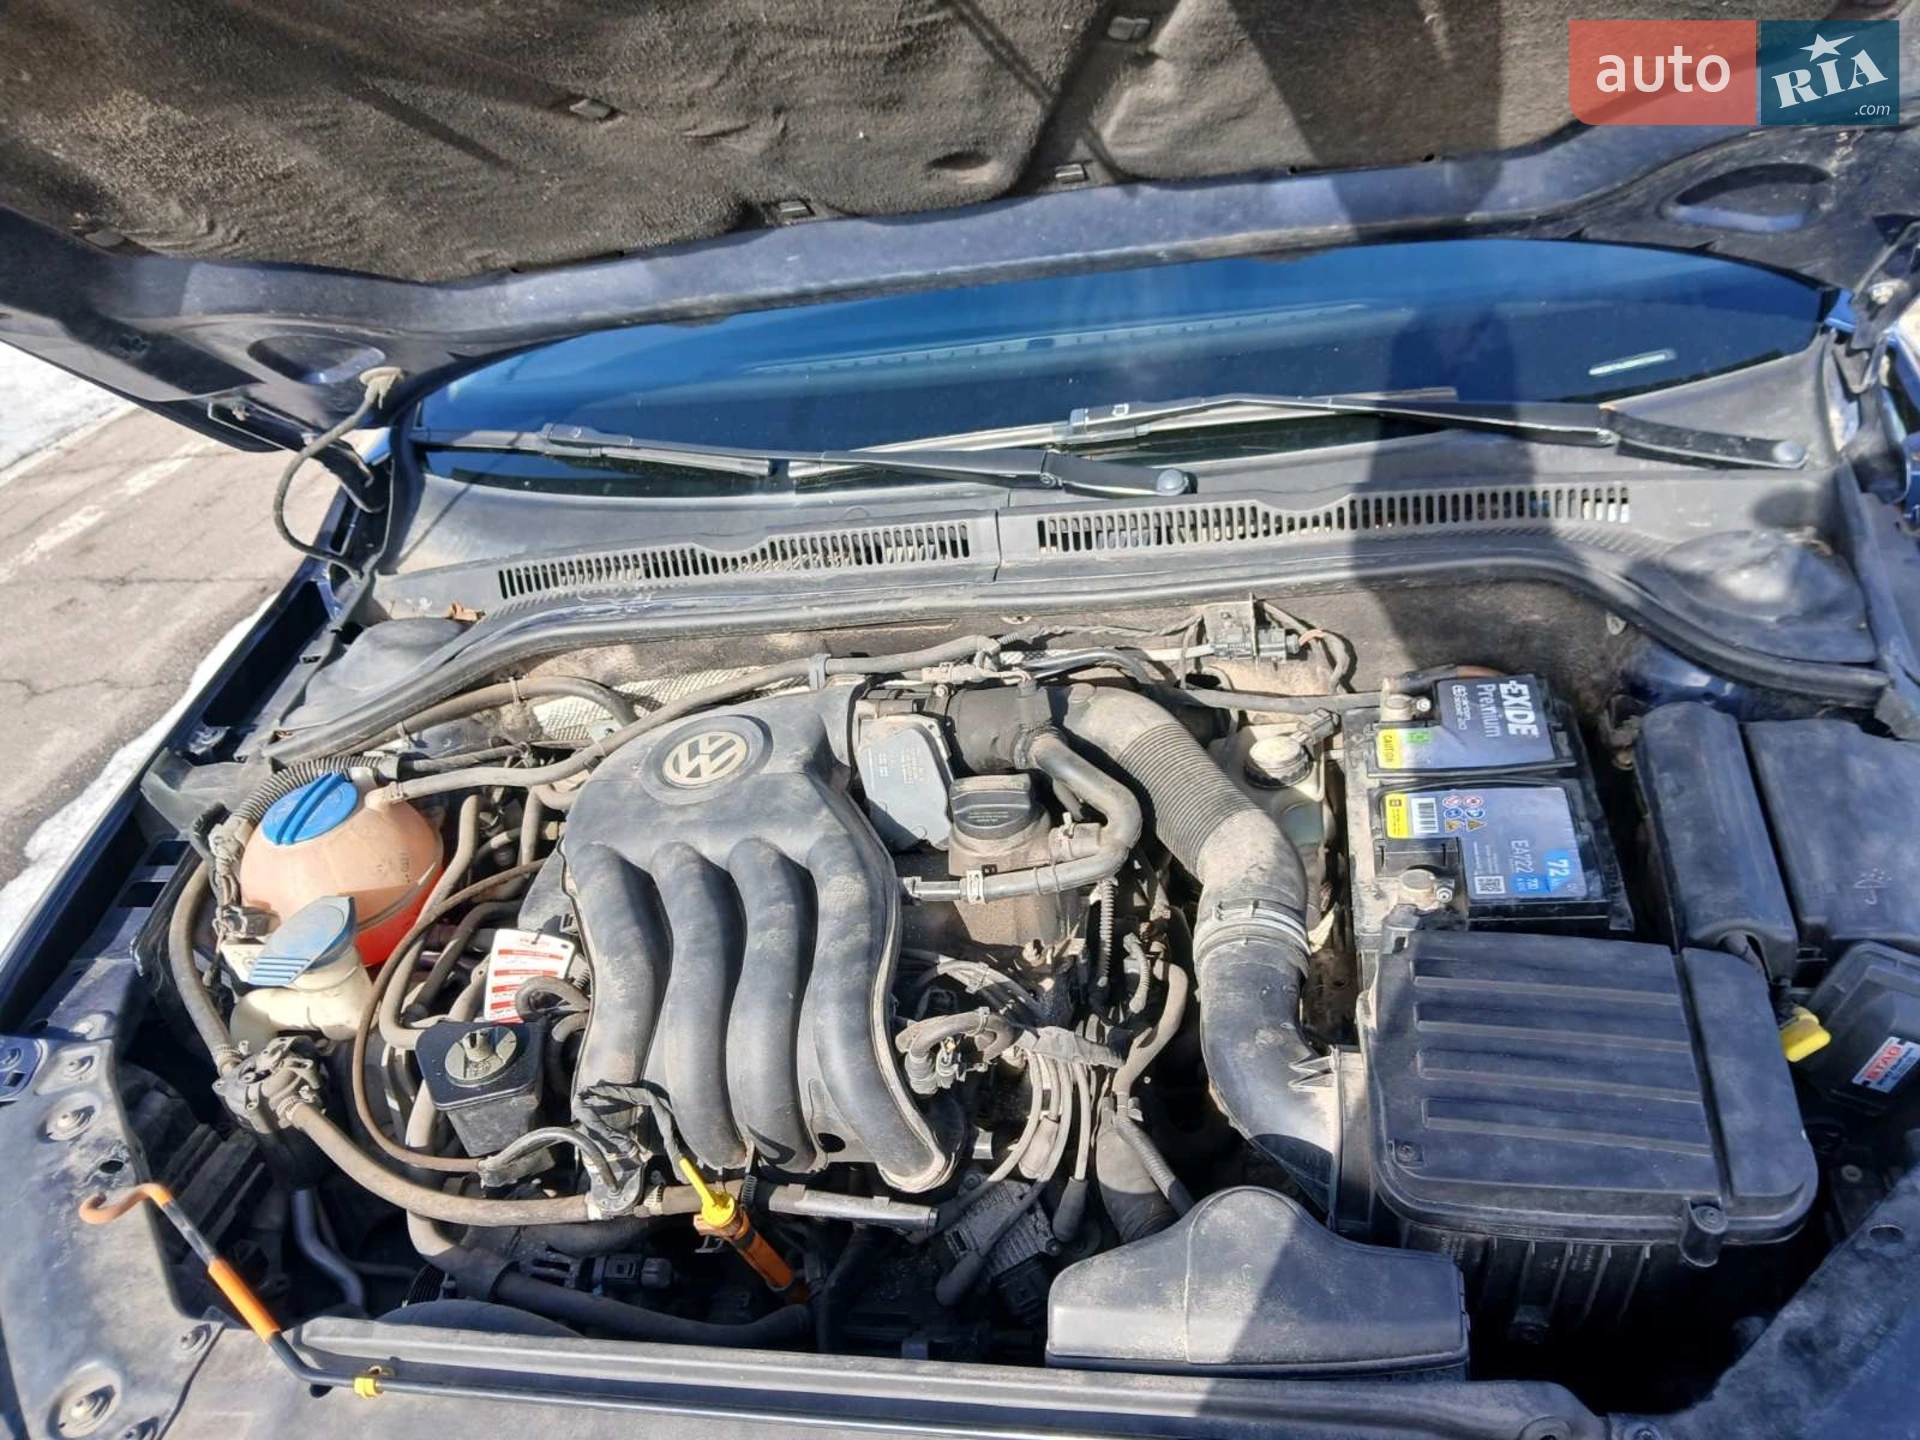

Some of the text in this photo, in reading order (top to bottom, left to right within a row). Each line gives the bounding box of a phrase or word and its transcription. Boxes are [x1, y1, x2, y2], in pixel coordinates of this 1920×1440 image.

[1476, 684, 1502, 737] Premium
[1499, 680, 1539, 738] EXIDE
[1511, 839, 1534, 874] EA722
[1546, 859, 1571, 877] 72
